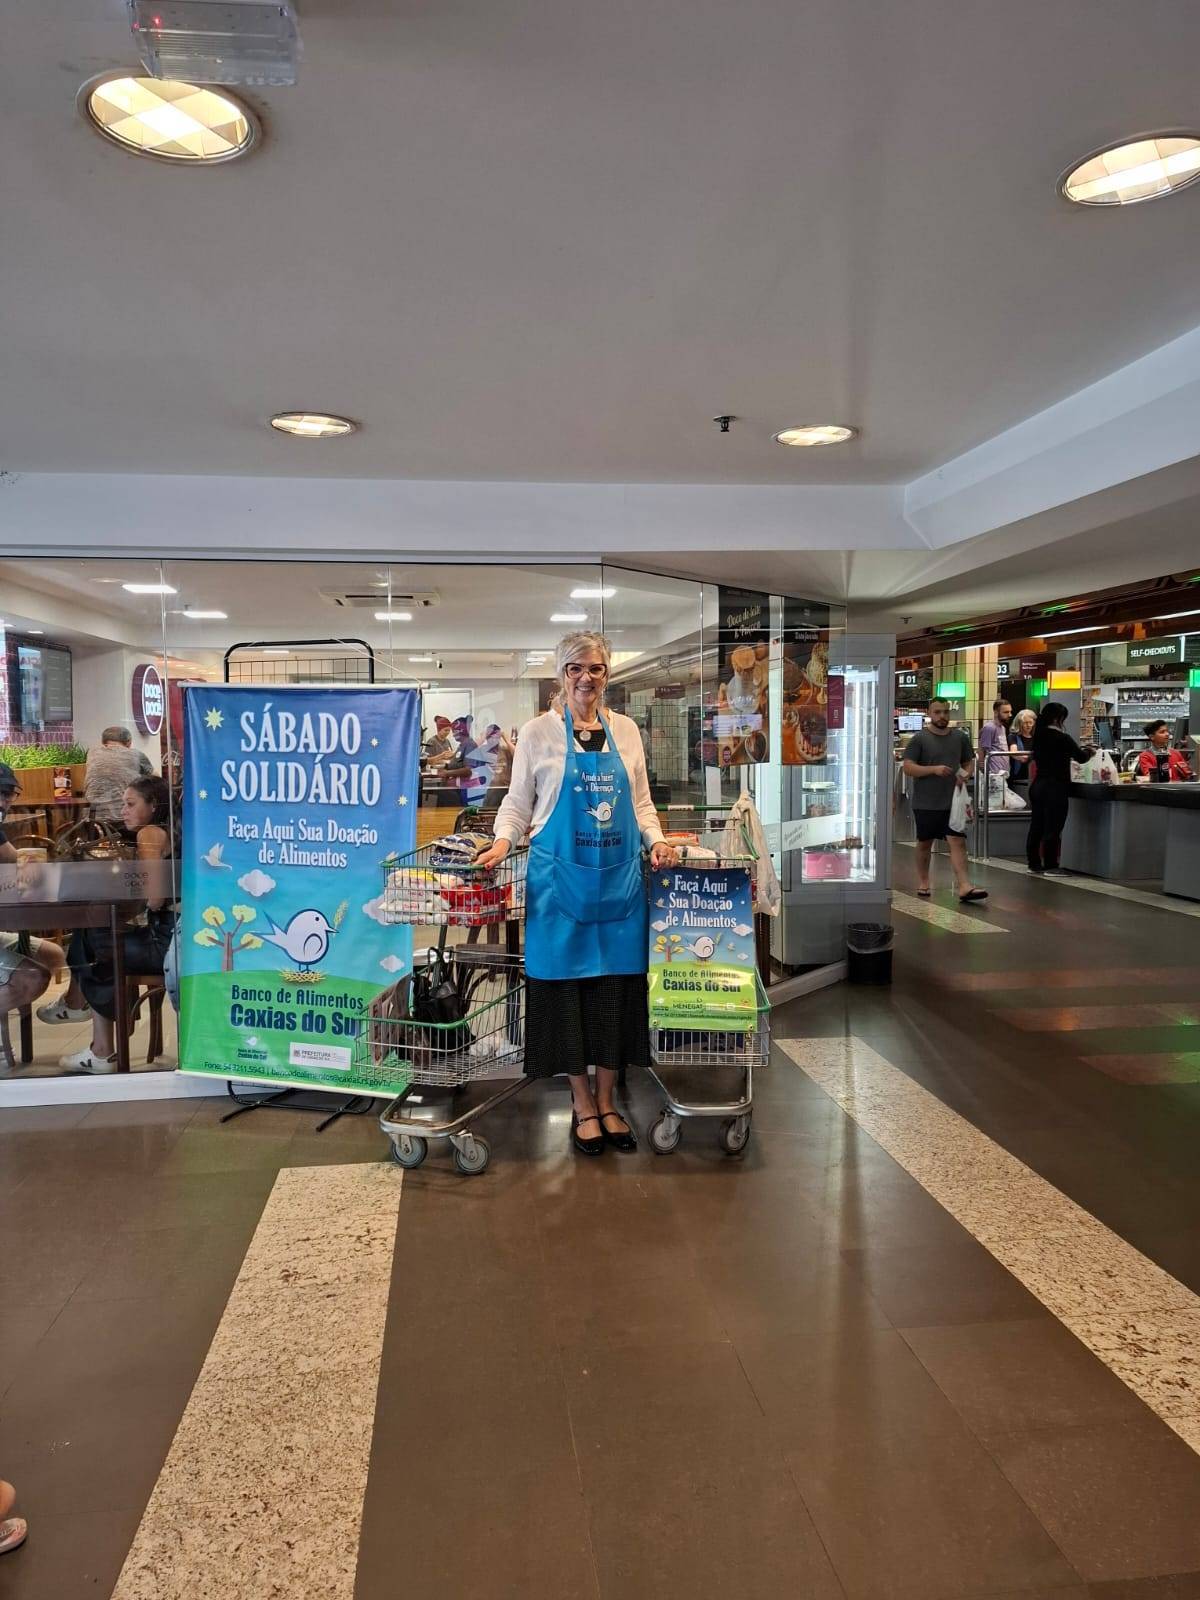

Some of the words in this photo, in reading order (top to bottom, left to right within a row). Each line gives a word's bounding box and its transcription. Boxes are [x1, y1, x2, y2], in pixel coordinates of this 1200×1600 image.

[1130, 646, 1176, 657] SELF-CHECKOUTS
[906, 675, 917, 683] 01
[240, 703, 362, 755] SÁBADO
[221, 754, 381, 806] SOLIDÁRIO
[228, 816, 259, 842] Faça
[263, 817, 294, 844] Aqui
[298, 819, 325, 841] Sua
[328, 820, 378, 847] Doação
[258, 842, 275, 864] de
[279, 844, 347, 868] Alimentos
[674, 874, 699, 893] Faça
[702, 877, 728, 896] Aqui
[669, 893, 689, 909] Sua
[692, 894, 733, 913] Doação
[665, 910, 679, 927] de
[682, 911, 737, 928] Alimentos
[663, 969, 687, 978] Banco
[689, 969, 698, 978] de
[663, 978, 702, 991] Caxias
[704, 980, 719, 992] do
[231, 984, 272, 1003] Banco
[277, 988, 292, 1003] de
[296, 990, 364, 1010] Alimentos
[230, 1003, 297, 1029] Caxias
[301, 1009, 326, 1033] do
